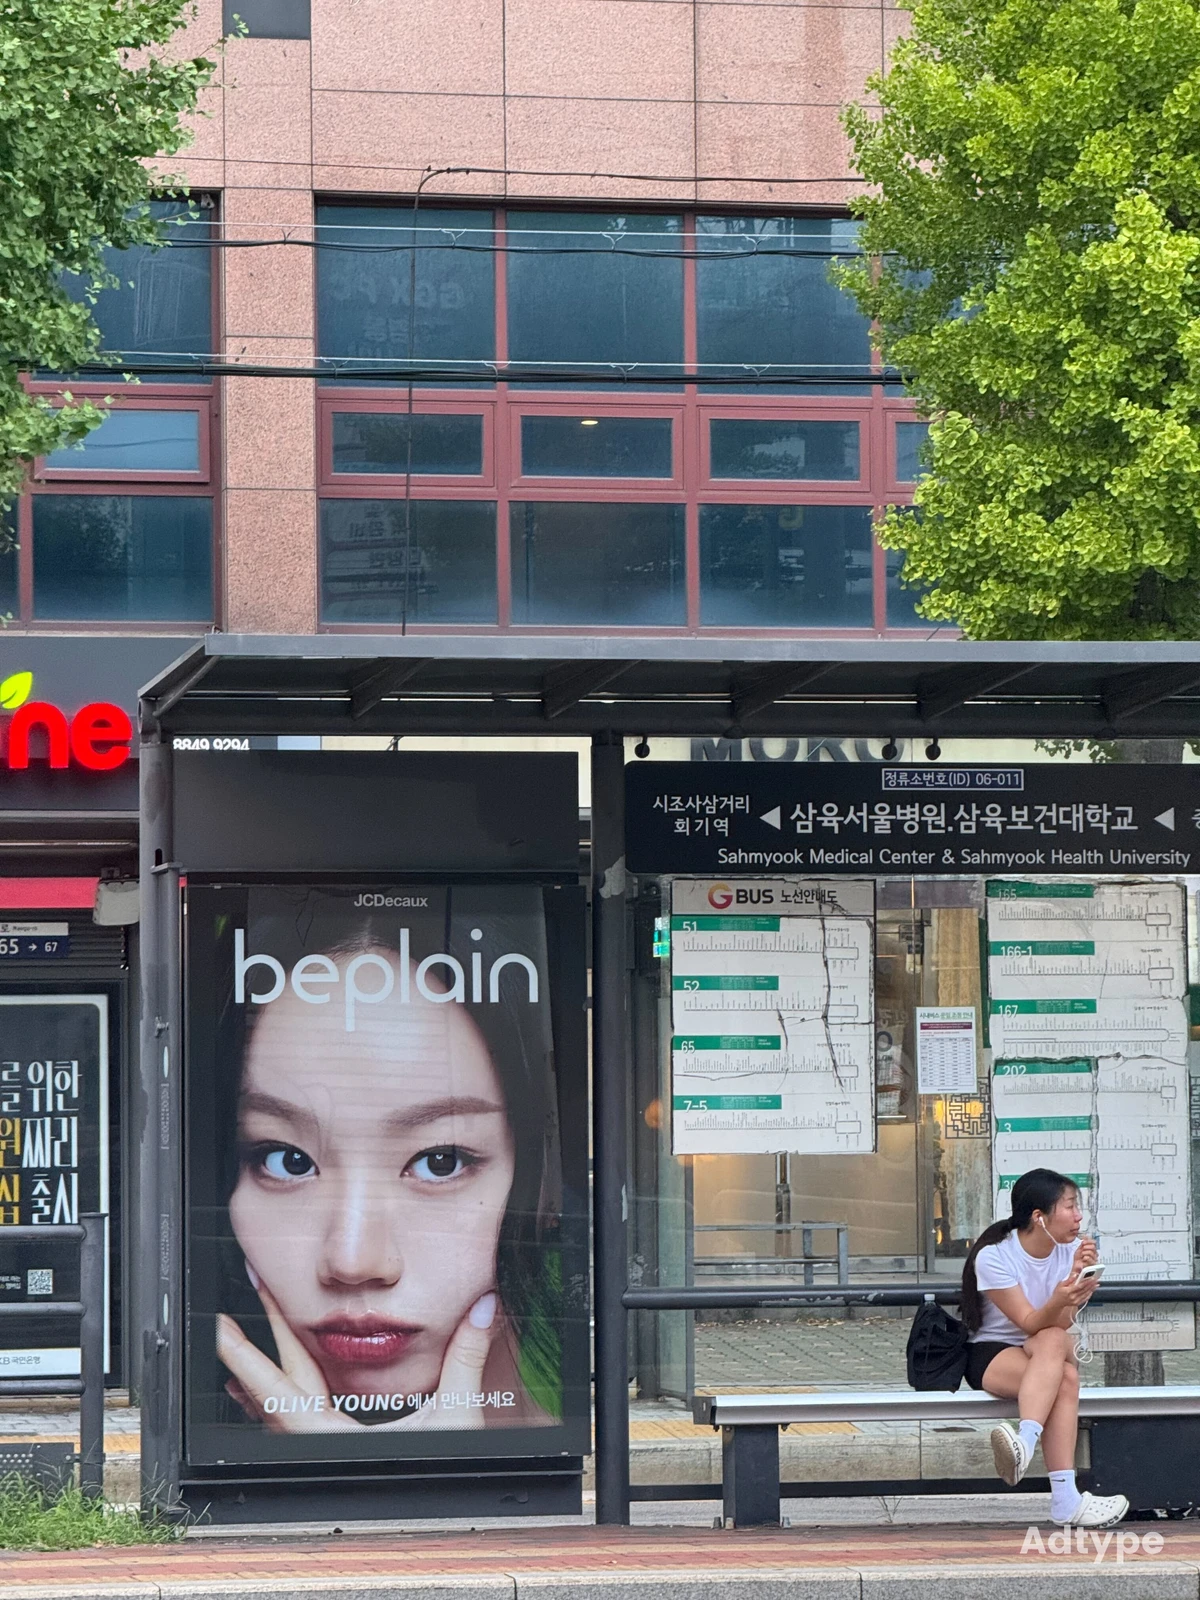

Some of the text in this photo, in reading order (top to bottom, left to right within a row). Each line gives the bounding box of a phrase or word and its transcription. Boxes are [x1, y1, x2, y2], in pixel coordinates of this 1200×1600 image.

[885, 772, 1020, 787] 정류소번호(ID) 06-011
[652, 794, 750, 815] 시조사삼거리
[673, 817, 730, 837] 회기역
[717, 848, 1191, 868] Sahmyook Medical Center & Sahmyook Health University
[353, 894, 428, 908] JCDecaux
[682, 921, 698, 934] 51
[44, 941, 58, 953] 67
[1000, 945, 1033, 958] 166-1
[234, 928, 539, 1032] beplain
[683, 980, 700, 993] 52
[998, 1004, 1018, 1018] 167
[681, 1041, 696, 1054] 65
[1002, 1065, 1027, 1077] 202
[683, 1100, 708, 1113] 7-5
[1004, 1123, 1012, 1134] 3
[31, 1173, 79, 1225] 출시
[263, 1395, 326, 1414] OLIVE
[440, 1390, 516, 1409] 만나보세요
